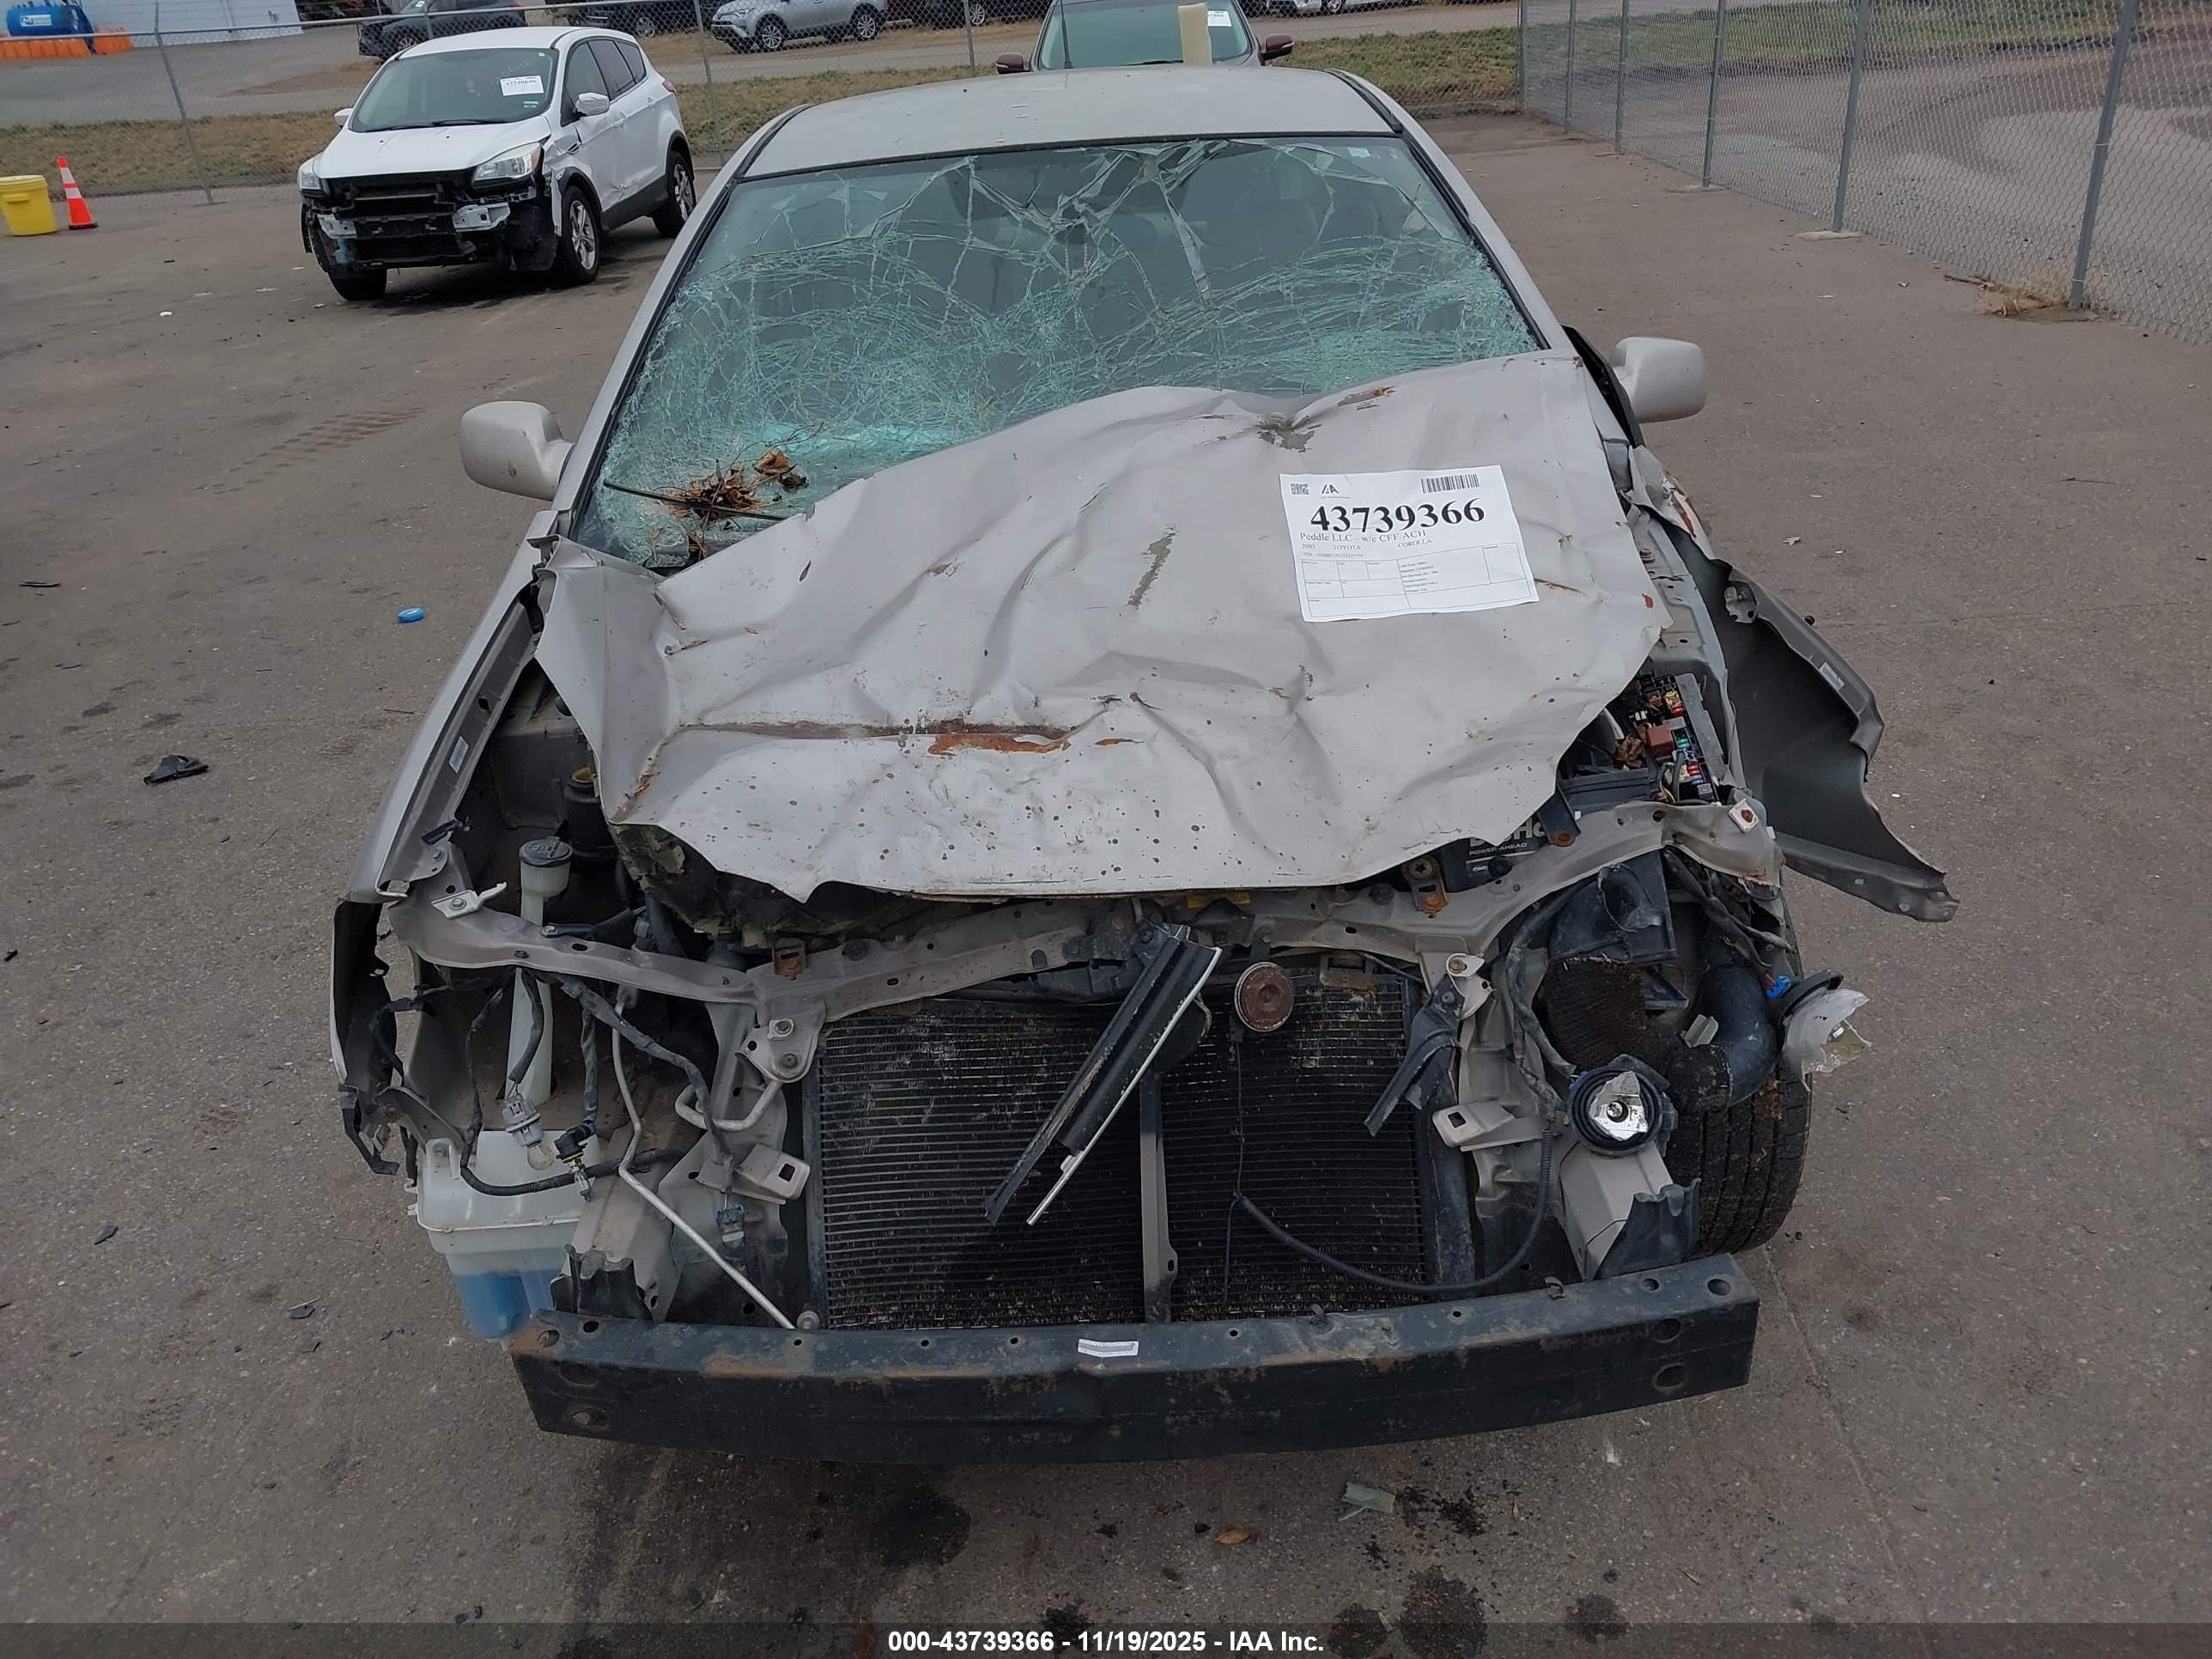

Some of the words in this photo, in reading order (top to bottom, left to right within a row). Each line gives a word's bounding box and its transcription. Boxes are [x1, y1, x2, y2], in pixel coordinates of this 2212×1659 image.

[1310, 497, 1485, 533] 43739366
[1300, 532, 1329, 542] Peddle
[1332, 533, 1352, 542] LLC
[1402, 529, 1426, 540] ACH
[1397, 538, 1432, 548] COROLLA
[1469, 847, 1498, 856] POWER
[1499, 842, 1528, 852] AHEAD
